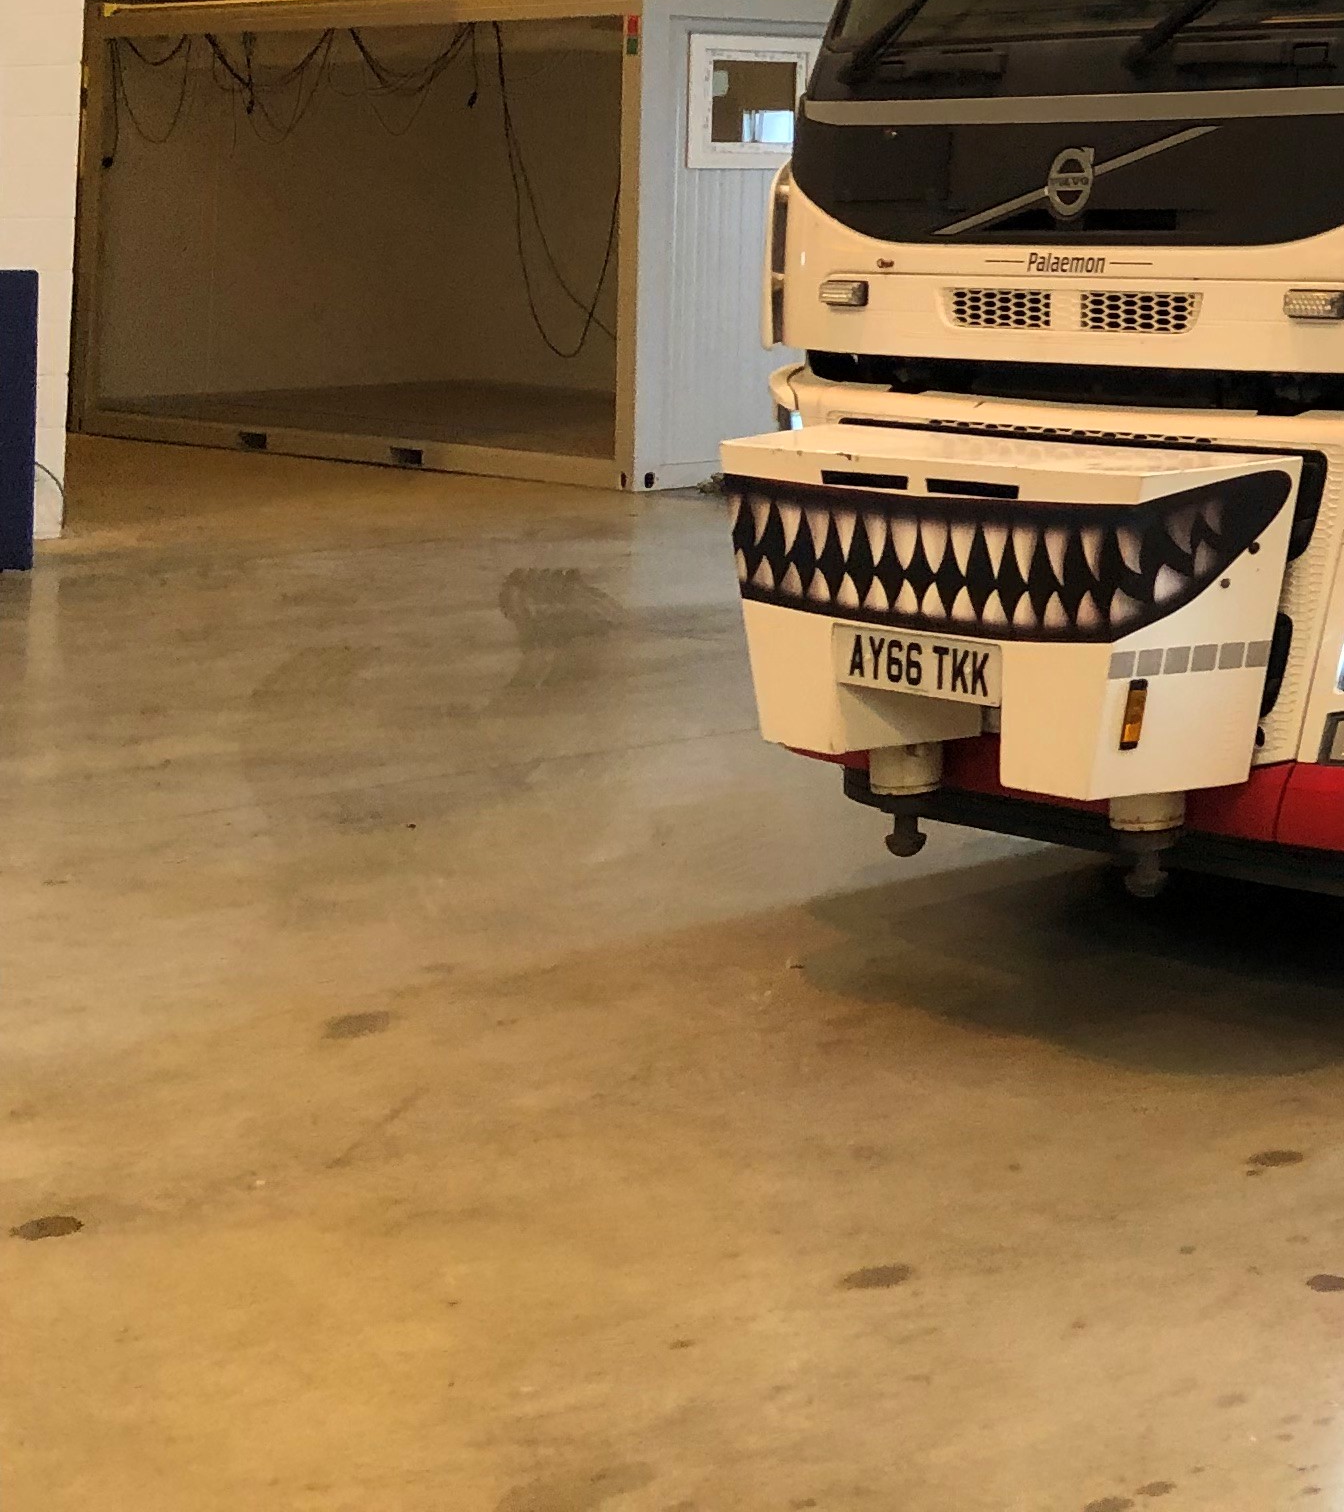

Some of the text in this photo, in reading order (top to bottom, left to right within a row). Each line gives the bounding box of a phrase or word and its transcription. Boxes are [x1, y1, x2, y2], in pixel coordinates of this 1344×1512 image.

[1026, 252, 1106, 274] Palaemon
[849, 634, 990, 698] AY66 TKK
